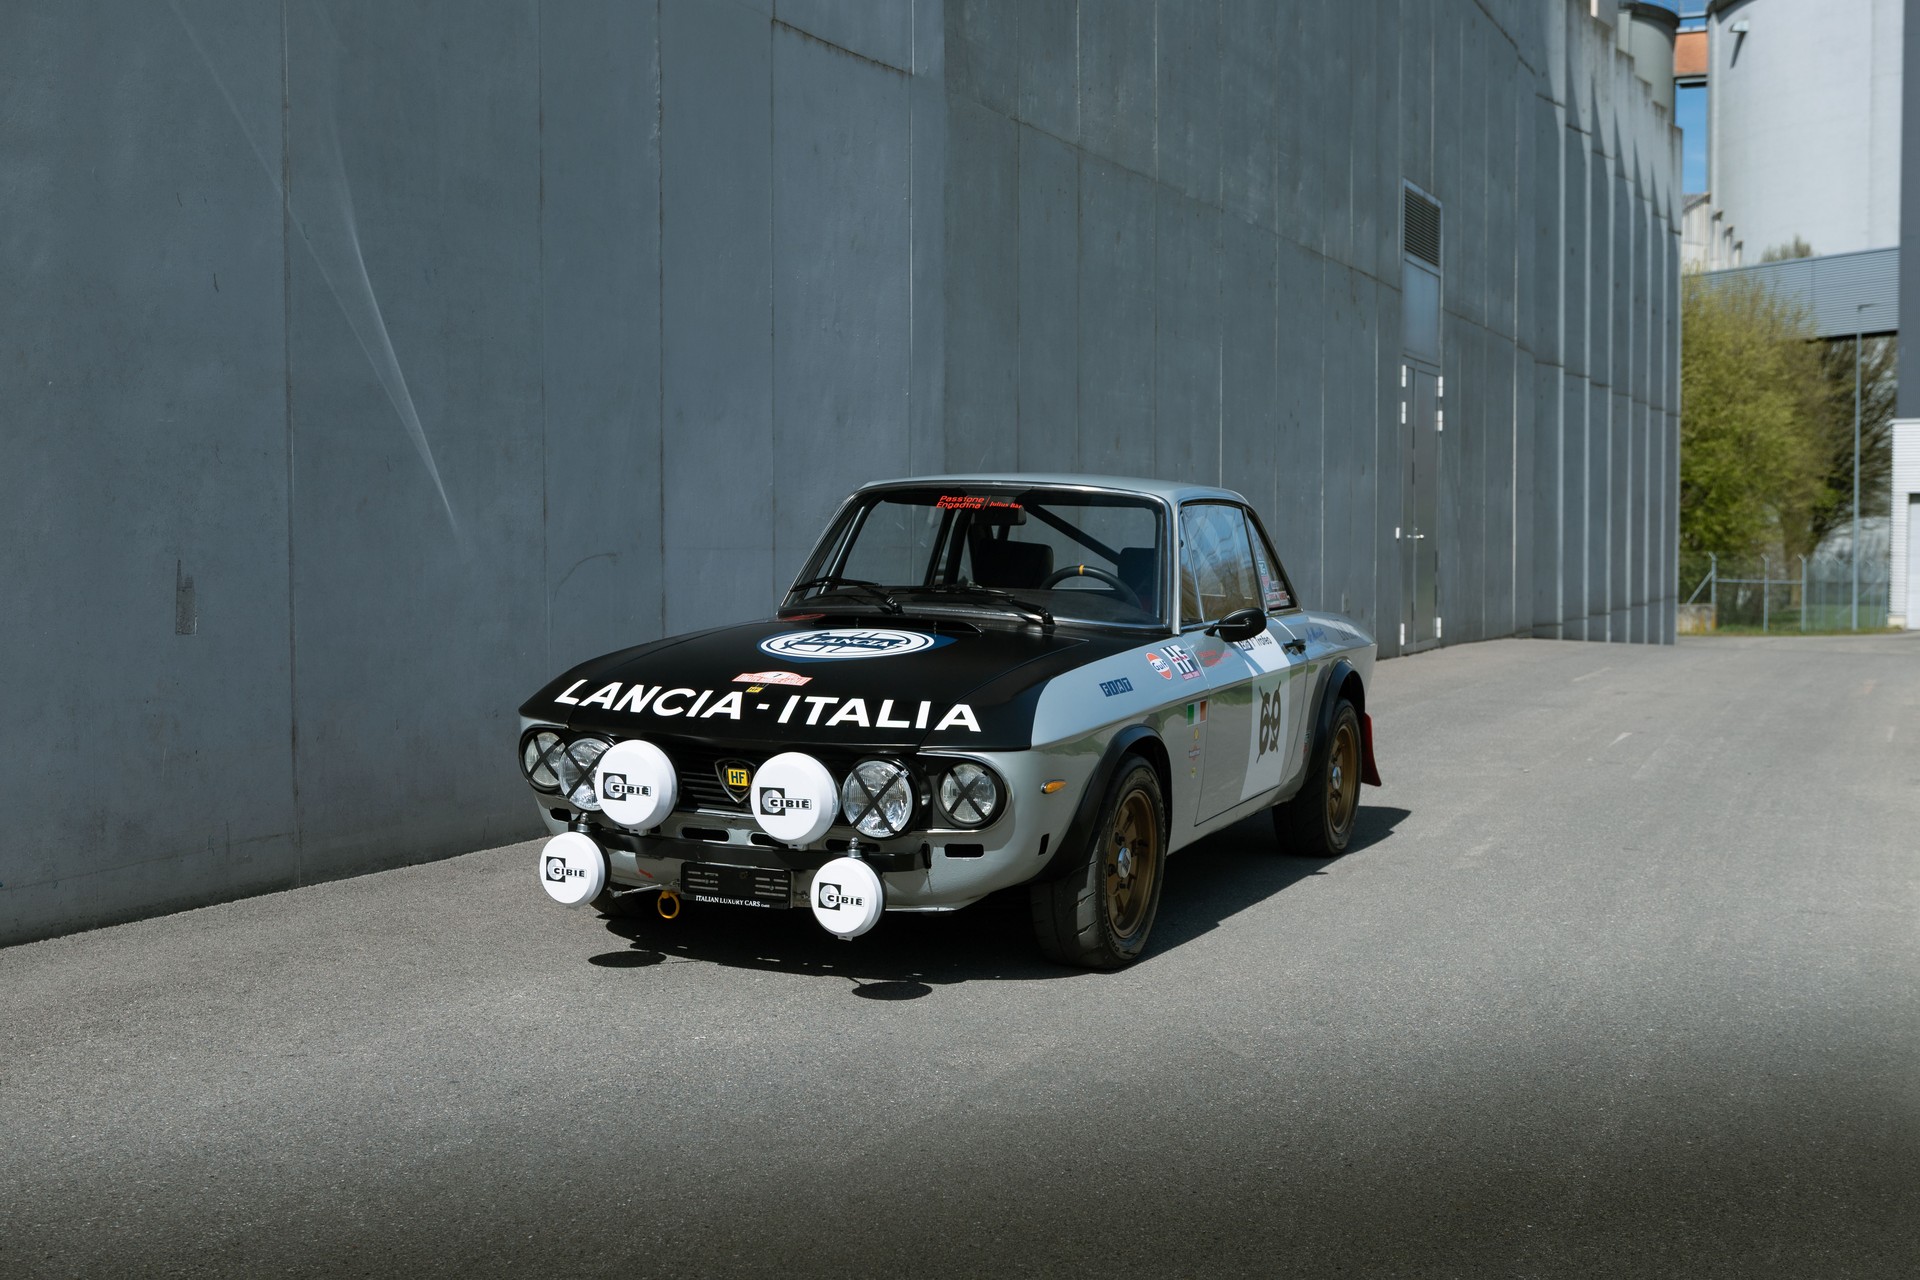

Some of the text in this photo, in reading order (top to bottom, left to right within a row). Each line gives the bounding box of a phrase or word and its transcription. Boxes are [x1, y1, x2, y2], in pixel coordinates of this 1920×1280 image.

[936, 501, 981, 509] Engadina
[807, 637, 890, 647] LANCIA
[1152, 660, 1169, 671] Gulf
[1100, 678, 1133, 697] FIAT
[554, 679, 742, 719] LANCIA
[778, 695, 981, 732] ITALIA
[730, 770, 746, 784] HF
[695, 895, 719, 903] ITALIAN
[720, 897, 744, 905] LUXURY
